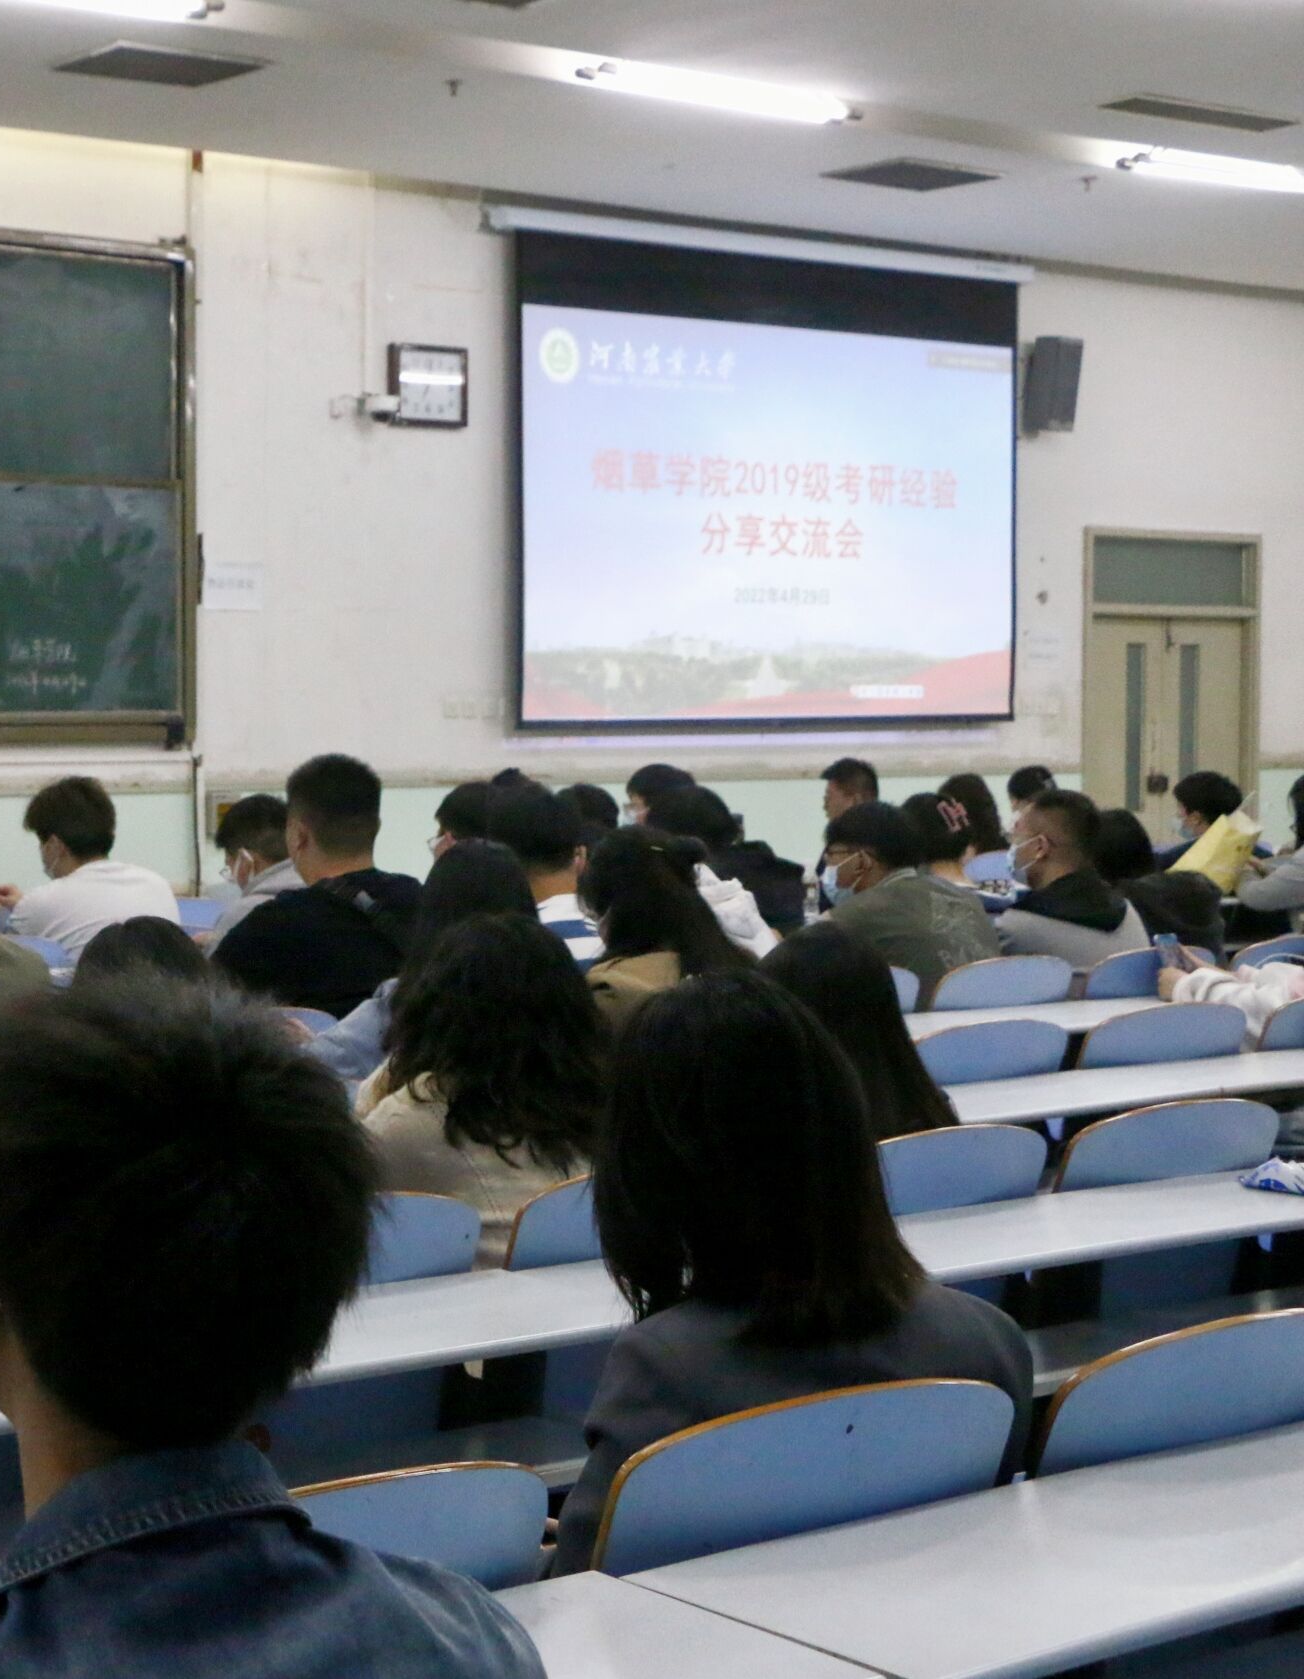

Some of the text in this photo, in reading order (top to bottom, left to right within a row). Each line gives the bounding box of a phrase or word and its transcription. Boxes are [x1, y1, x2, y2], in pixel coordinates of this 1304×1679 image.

[590, 448, 959, 510] 烟草学院2019级考研经验
[700, 513, 864, 560] 分享交流会
